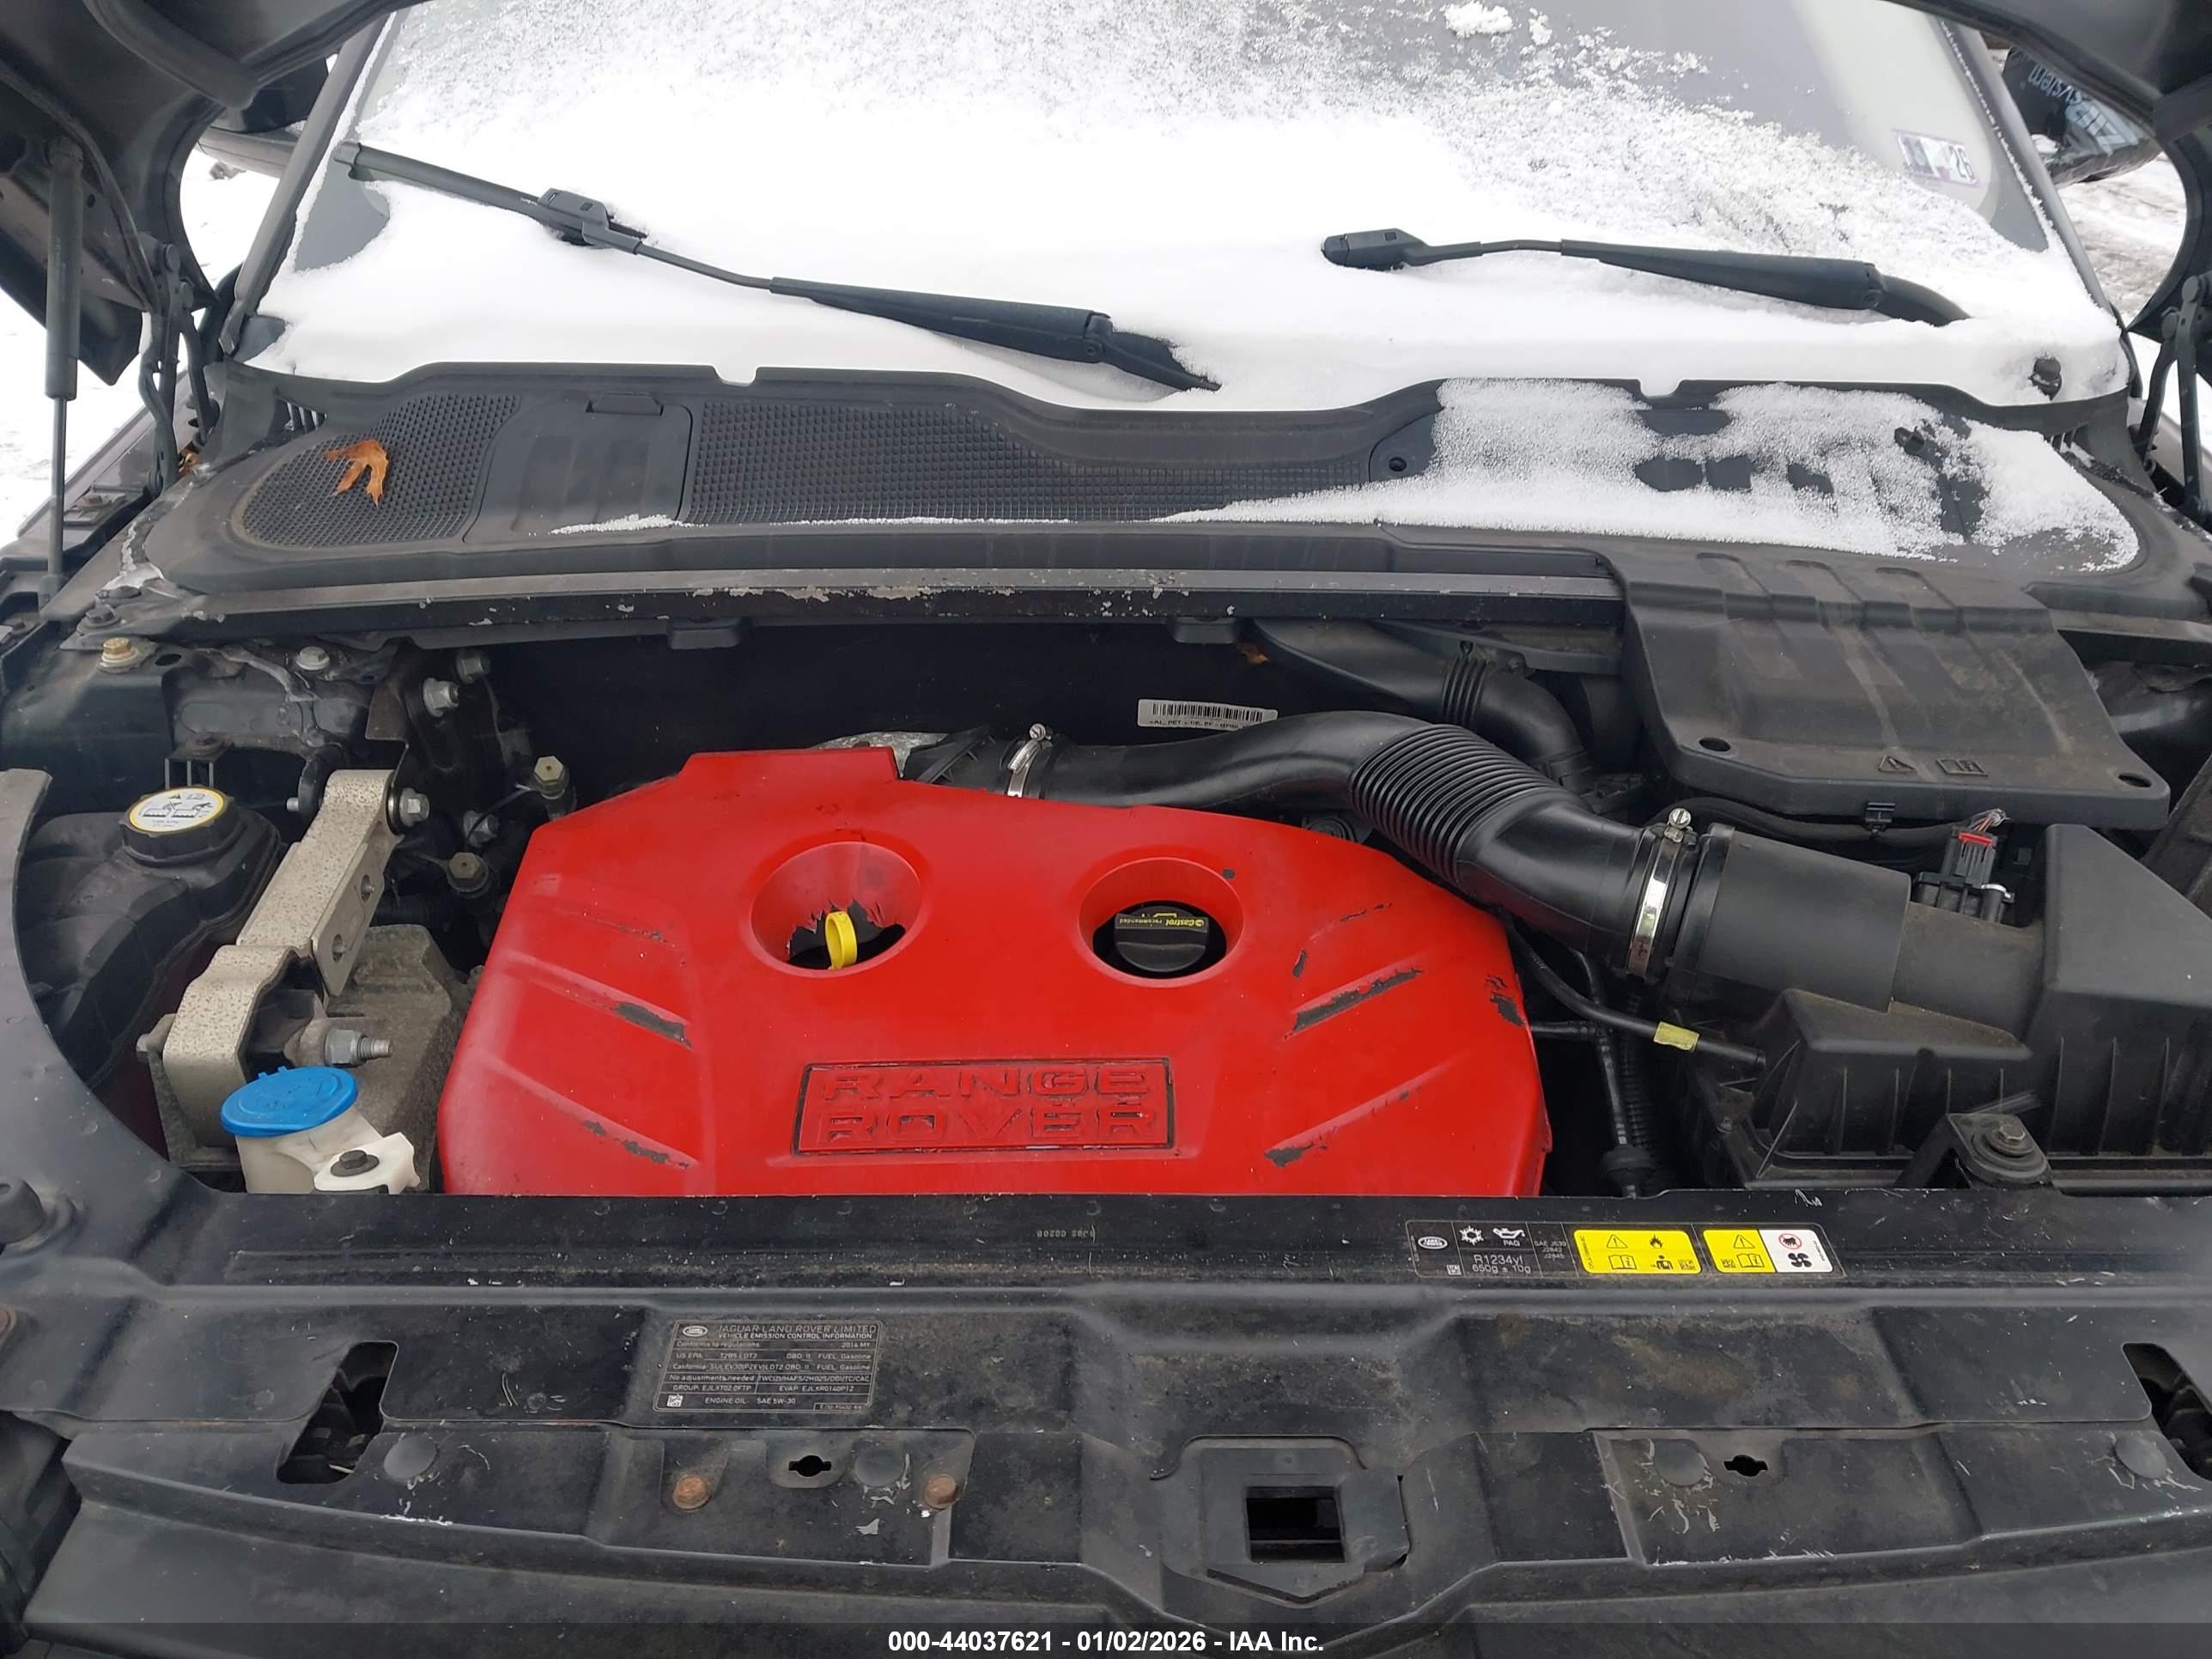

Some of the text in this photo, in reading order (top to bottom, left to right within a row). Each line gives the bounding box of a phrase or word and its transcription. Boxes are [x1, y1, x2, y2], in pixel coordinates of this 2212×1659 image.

[2028, 64, 2082, 105] system
[1948, 144, 1977, 180] 26
[822, 1066, 1151, 1100] RANGE
[817, 1103, 1155, 1143] ROVER
[1472, 1264, 1498, 1273] 650g
[1513, 1265, 1531, 1274] 10g
